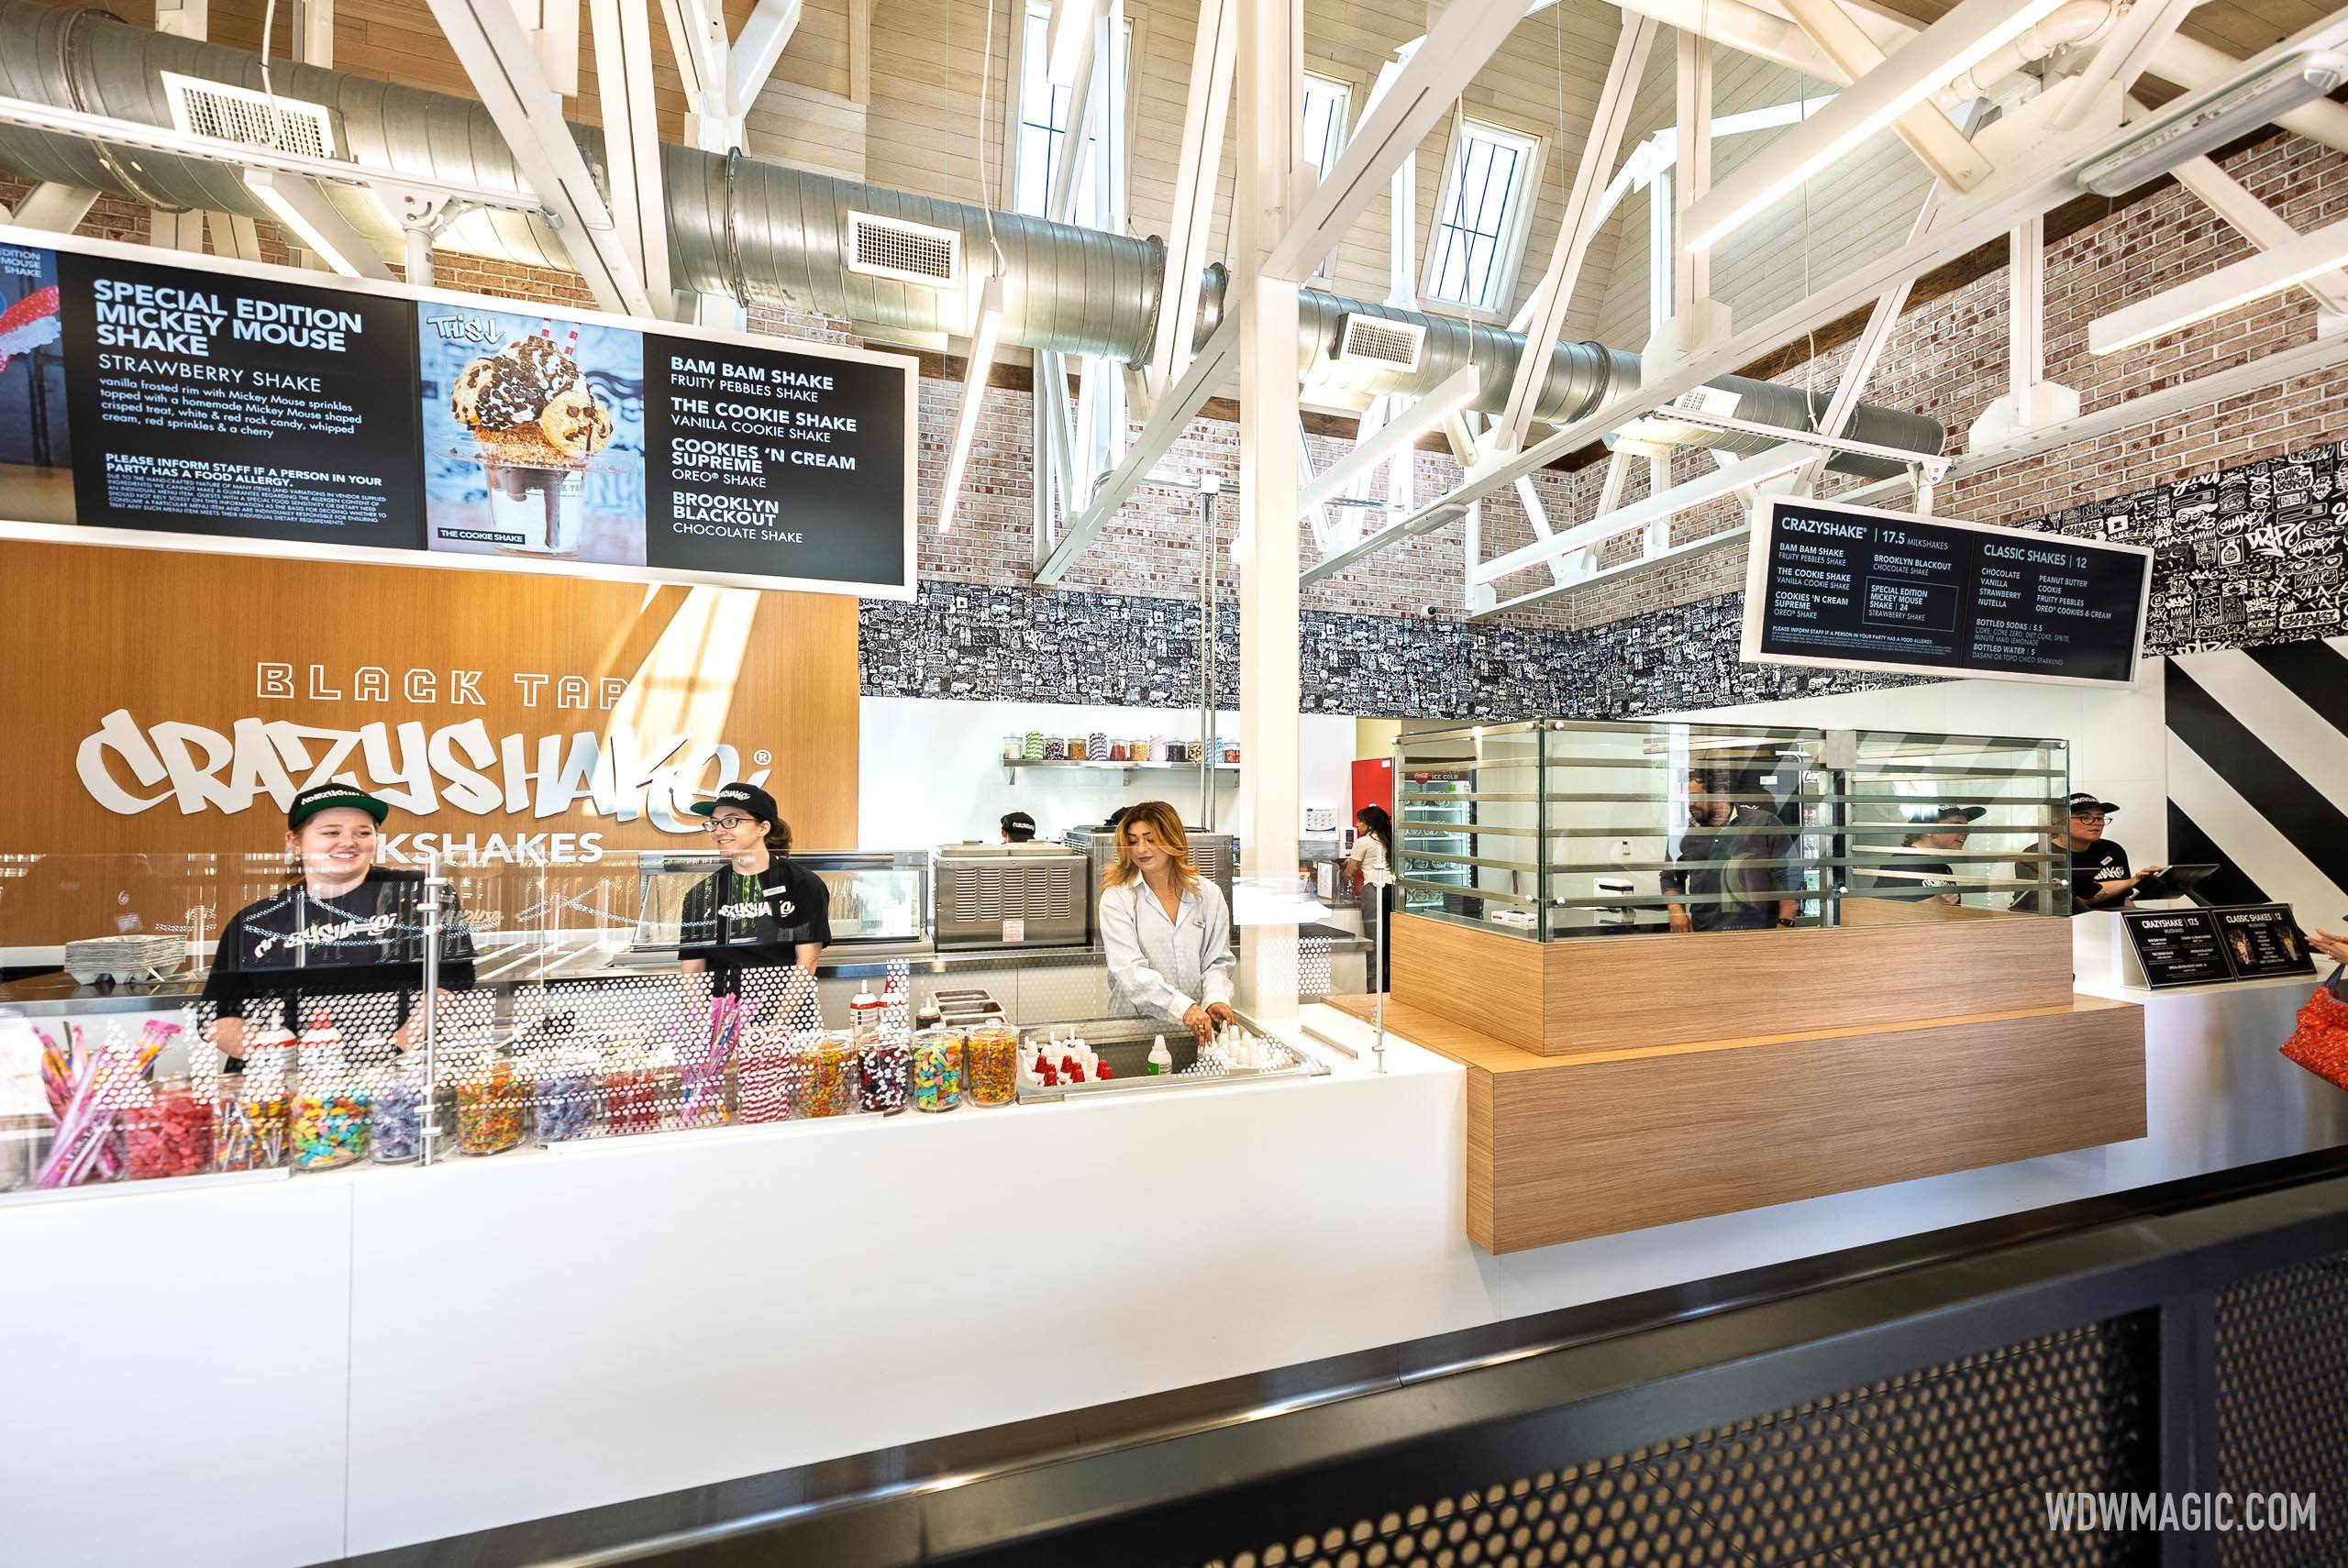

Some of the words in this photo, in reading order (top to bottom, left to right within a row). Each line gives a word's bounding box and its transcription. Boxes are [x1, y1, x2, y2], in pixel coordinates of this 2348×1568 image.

[0, 248, 41, 260] DITION
[1, 257, 41, 269] MOUSE
[4, 265, 42, 278] SHAKE
[94, 281, 227, 316] SPECIAL
[237, 298, 361, 333] EDITION
[96, 303, 224, 337] MICKEY
[233, 319, 345, 351] MOUSE
[97, 326, 208, 357] SHAKE
[99, 355, 243, 383] STRAWBERRY
[252, 371, 320, 392] SHAKE
[671, 356, 714, 374] BAM
[722, 362, 764, 381] BAM
[771, 369, 833, 389] SHAKE
[671, 373, 714, 389] FRUITY
[720, 380, 770, 395] PEBBLES
[776, 386, 817, 401] SHAKE
[99, 376, 137, 389] vanilla
[140, 381, 178, 393] frosted
[182, 384, 199, 395] rim
[203, 387, 225, 398] with
[228, 390, 267, 405] Mickey
[270, 393, 305, 406] Mouse
[308, 398, 352, 414] sprinkles
[100, 388, 140, 403] topped
[144, 392, 167, 403] with
[182, 396, 242, 412] homemade
[245, 403, 283, 418] Mickey
[286, 407, 321, 420] Mouse
[325, 411, 361, 426] shaped
[670, 397, 708, 414] THE
[715, 402, 789, 423] COOKIE
[796, 411, 856, 430] SHAKE
[101, 400, 142, 415] crisped
[146, 403, 173, 418] treat,
[178, 407, 207, 419] white
[211, 411, 219, 420] &
[223, 412, 241, 423] red
[245, 414, 267, 425] rock
[270, 416, 305, 432] candy,
[309, 420, 354, 436] whipped
[102, 413, 140, 426] cream,
[145, 415, 163, 426] red
[167, 417, 214, 434] sprinkles
[216, 422, 226, 432] &
[240, 425, 273, 439] cherry
[671, 414, 726, 430] VANILLA
[731, 421, 783, 436] COOKIE
[789, 426, 830, 441] SHAKE
[671, 437, 758, 458] COOKIES
[791, 449, 855, 469] CREAM
[671, 452, 762, 472] SUPREME
[105, 454, 153, 466] PLEASE
[158, 458, 209, 470] INFORM
[213, 463, 249, 474] STAFF
[253, 467, 264, 475] IF
[268, 468, 277, 477] A
[281, 469, 328, 480] PERSON
[332, 473, 345, 482] IN
[348, 475, 382, 486] YOUR
[106, 463, 148, 474] PARTY
[151, 467, 178, 477] HAS
[182, 469, 191, 478] A
[194, 470, 232, 481] FOOD
[235, 474, 293, 487] ALLERGY.
[723, 473, 765, 486] SHAKE
[673, 491, 778, 513] BROOKLYN
[673, 506, 776, 525] BLACKOUT
[440, 530, 458, 538] THE
[460, 532, 493, 540] COOKIE
[494, 534, 523, 543] SHAKE
[673, 523, 755, 538] CHOCOLATE
[761, 529, 802, 542] SHAKE
[1882, 529, 1905, 544] 17.5
[1779, 543, 1798, 552] BAM
[1799, 546, 1817, 554] BAM
[1818, 547, 1844, 557] SHAKE
[1983, 545, 2025, 560] CLASSIC
[2027, 550, 2066, 565] SHAKES
[2076, 557, 2088, 568] 12
[1778, 552, 1800, 560] FRUITY
[1800, 554, 1825, 563] PEBBLES
[1826, 558, 1846, 566] SHAKE
[1874, 555, 1913, 566] BROOKLYN
[1914, 559, 1952, 570] BLACKOUT
[1778, 568, 1792, 576] THE
[1794, 569, 1824, 579] COOKIE
[1826, 572, 1851, 581] SHAKE
[1873, 564, 1909, 573] CHOCOLATE
[1910, 568, 1928, 576] SHAKE
[1981, 569, 2021, 579] CHOCOLATE
[1777, 576, 1802, 585] VANILLA
[1803, 579, 1829, 588] COOKIE
[1830, 581, 1849, 590] SHAKE
[1980, 579, 2008, 587] VANILLA
[2039, 576, 2064, 584] PEANUT
[2065, 578, 2088, 587] BUTTER
[1871, 585, 1899, 594] SPECIAL
[1899, 588, 1928, 597] EDITION
[1979, 589, 2021, 599] STRAWBERRY
[2037, 585, 2062, 593] COOKIE
[1775, 591, 1810, 602] COOKIES
[1822, 596, 1848, 605] CREAM
[1775, 600, 1811, 610] SUPREME
[1869, 601, 1893, 609] SHAKE
[1870, 593, 1897, 602] MICKEY
[1898, 596, 1922, 604] MOUSE
[1977, 598, 2007, 607] NUTELLA
[2036, 595, 2058, 603] FRUITY
[2058, 598, 2084, 606] PEBBLES
[1797, 611, 1817, 619] SHAKE
[1868, 610, 1906, 619] STRAWBERRY
[2056, 607, 2084, 616] COOKIES
[2090, 611, 2111, 619] CREAM
[1976, 619, 2005, 627] BOTTLED
[2006, 622, 2027, 630] SODAS
[1973, 644, 2002, 652] BOTTLED
[2003, 646, 2025, 655] WATER
[257, 661, 486, 705] BLACK
[513, 672, 629, 712] TAP
